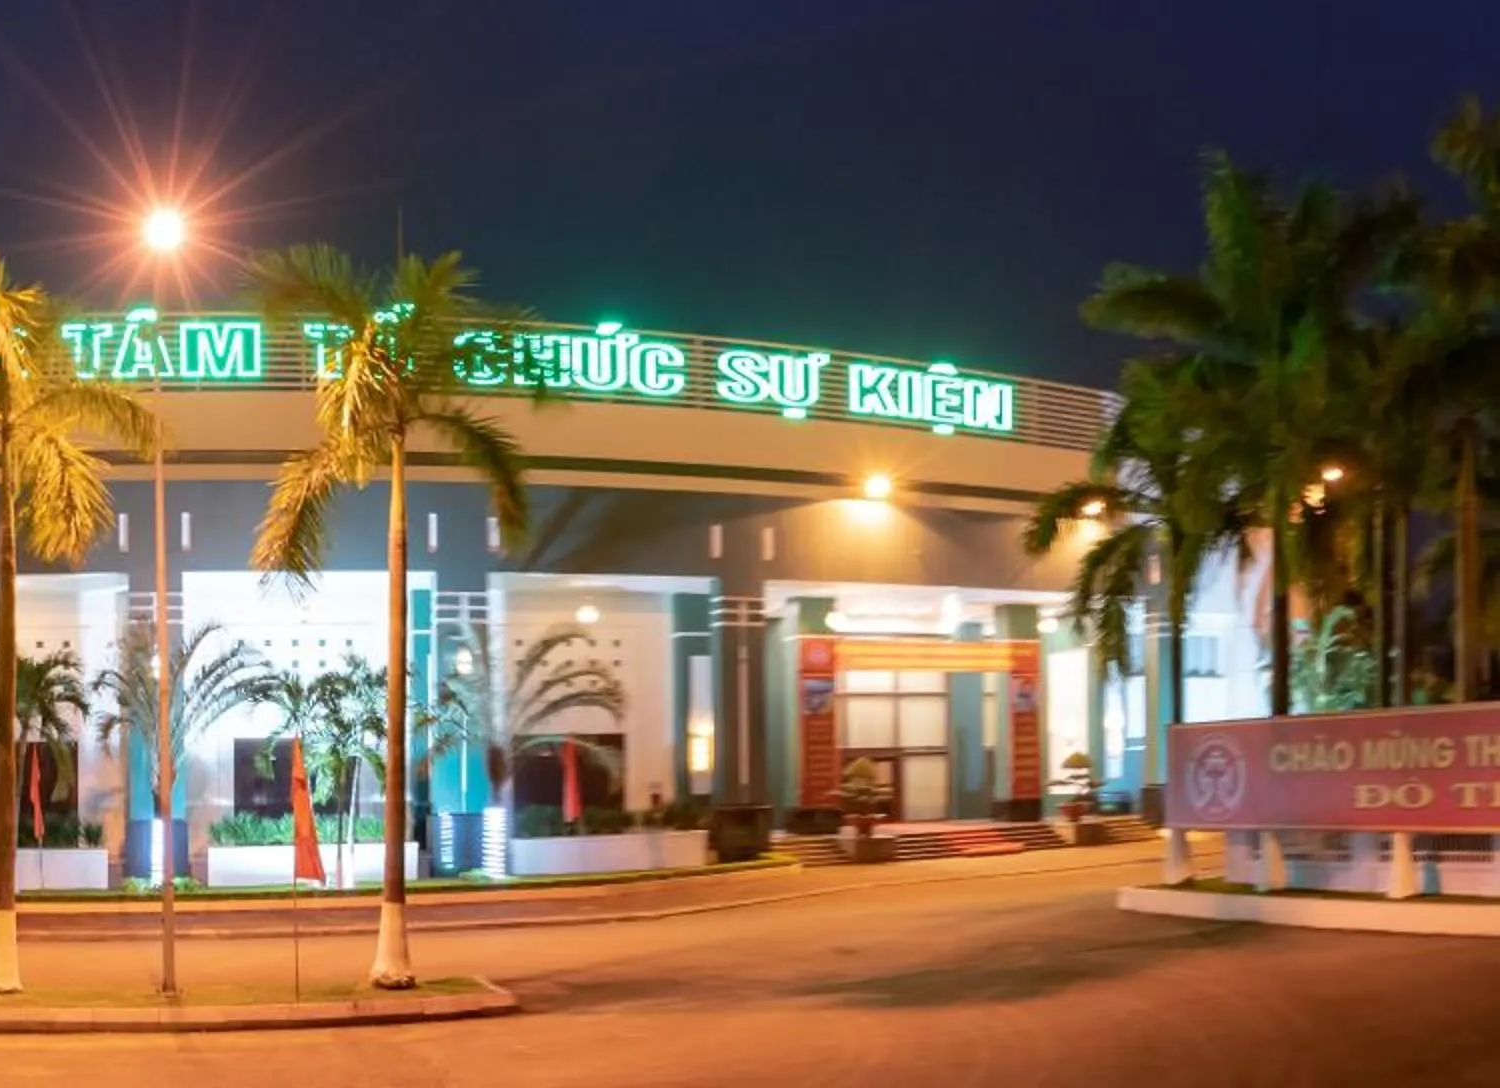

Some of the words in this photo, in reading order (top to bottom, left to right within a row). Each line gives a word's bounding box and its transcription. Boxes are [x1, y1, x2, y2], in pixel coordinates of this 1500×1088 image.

[61, 307, 262, 378] TÂM
[453, 322, 685, 397] CHỨC
[716, 350, 831, 419] SỰ
[848, 362, 1013, 435] KIỆN
[1355, 777, 1435, 809] ĐÔ
